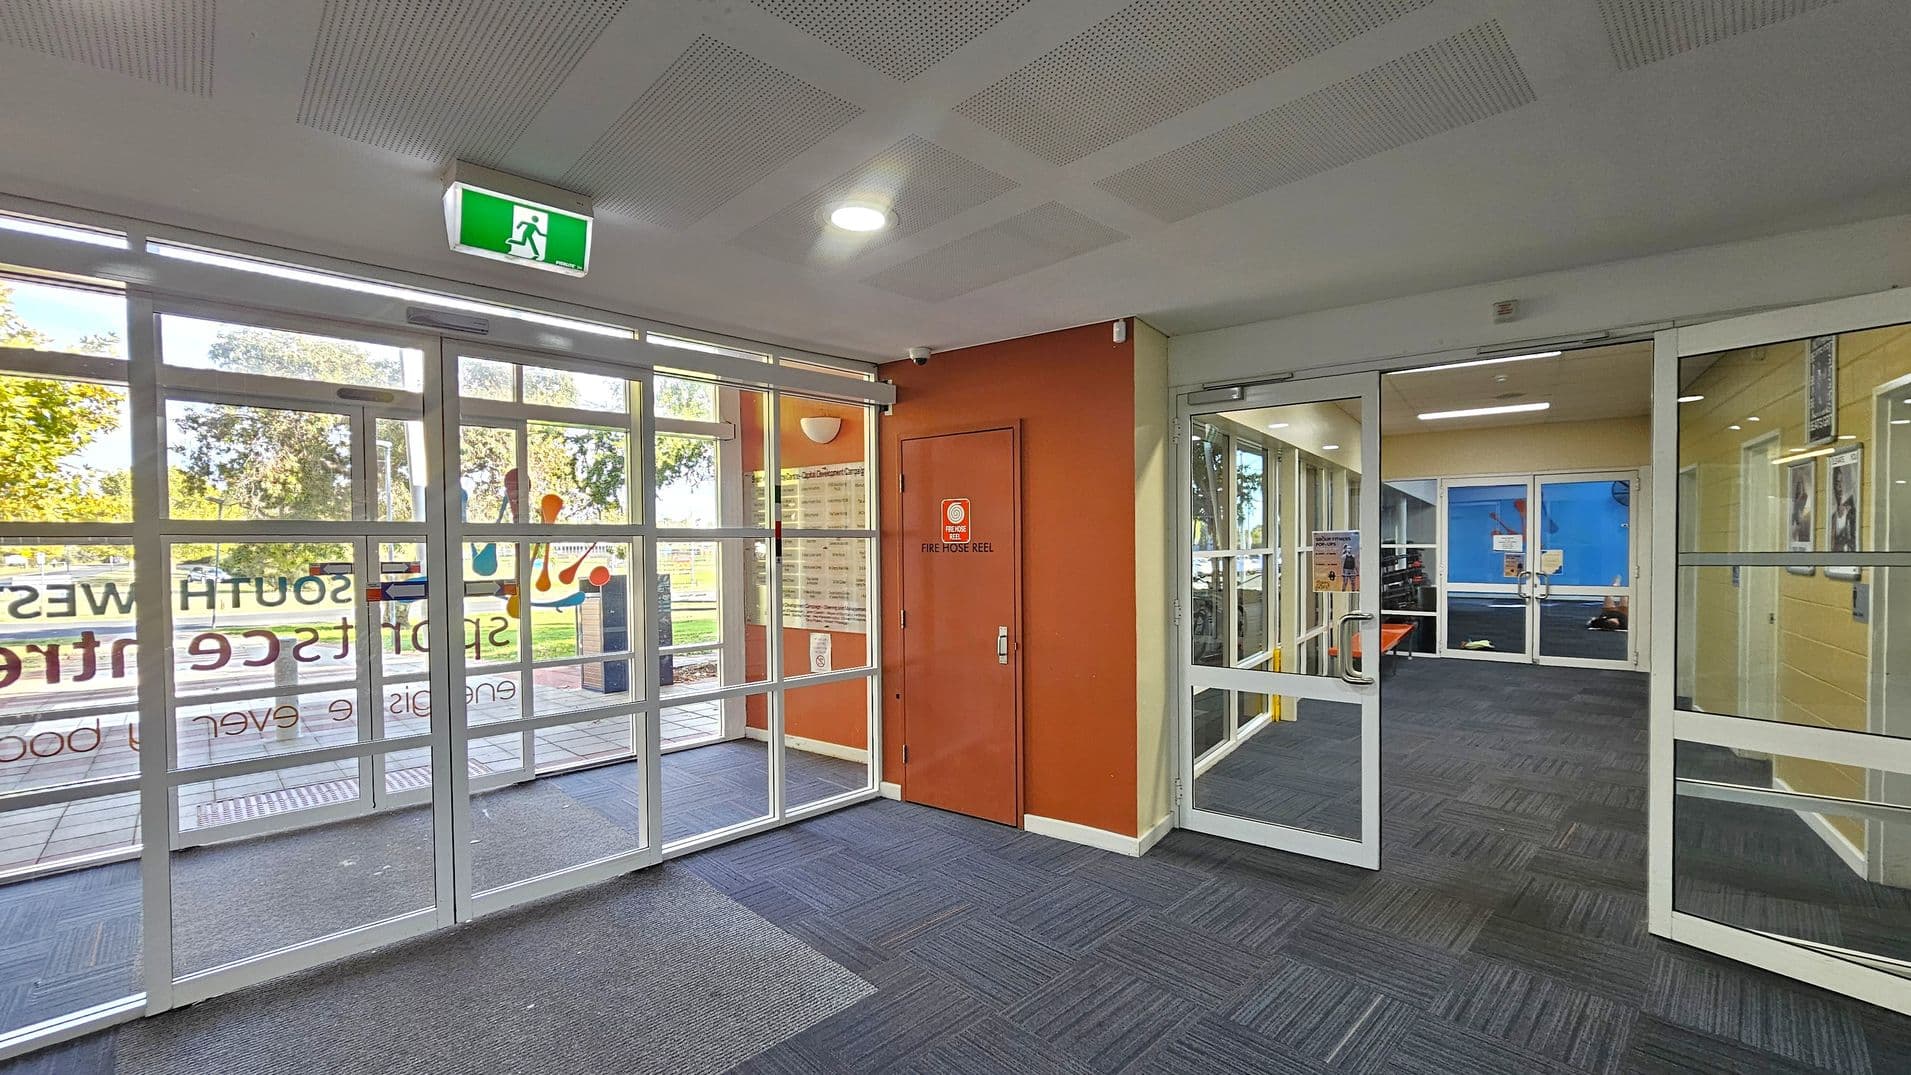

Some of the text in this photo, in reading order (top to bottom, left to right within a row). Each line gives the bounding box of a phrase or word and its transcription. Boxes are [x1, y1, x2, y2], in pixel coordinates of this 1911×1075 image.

[816, 469, 844, 478] Development
[845, 467, 864, 476] Campaig
[921, 542, 994, 553] FIRE HOSE REEL
